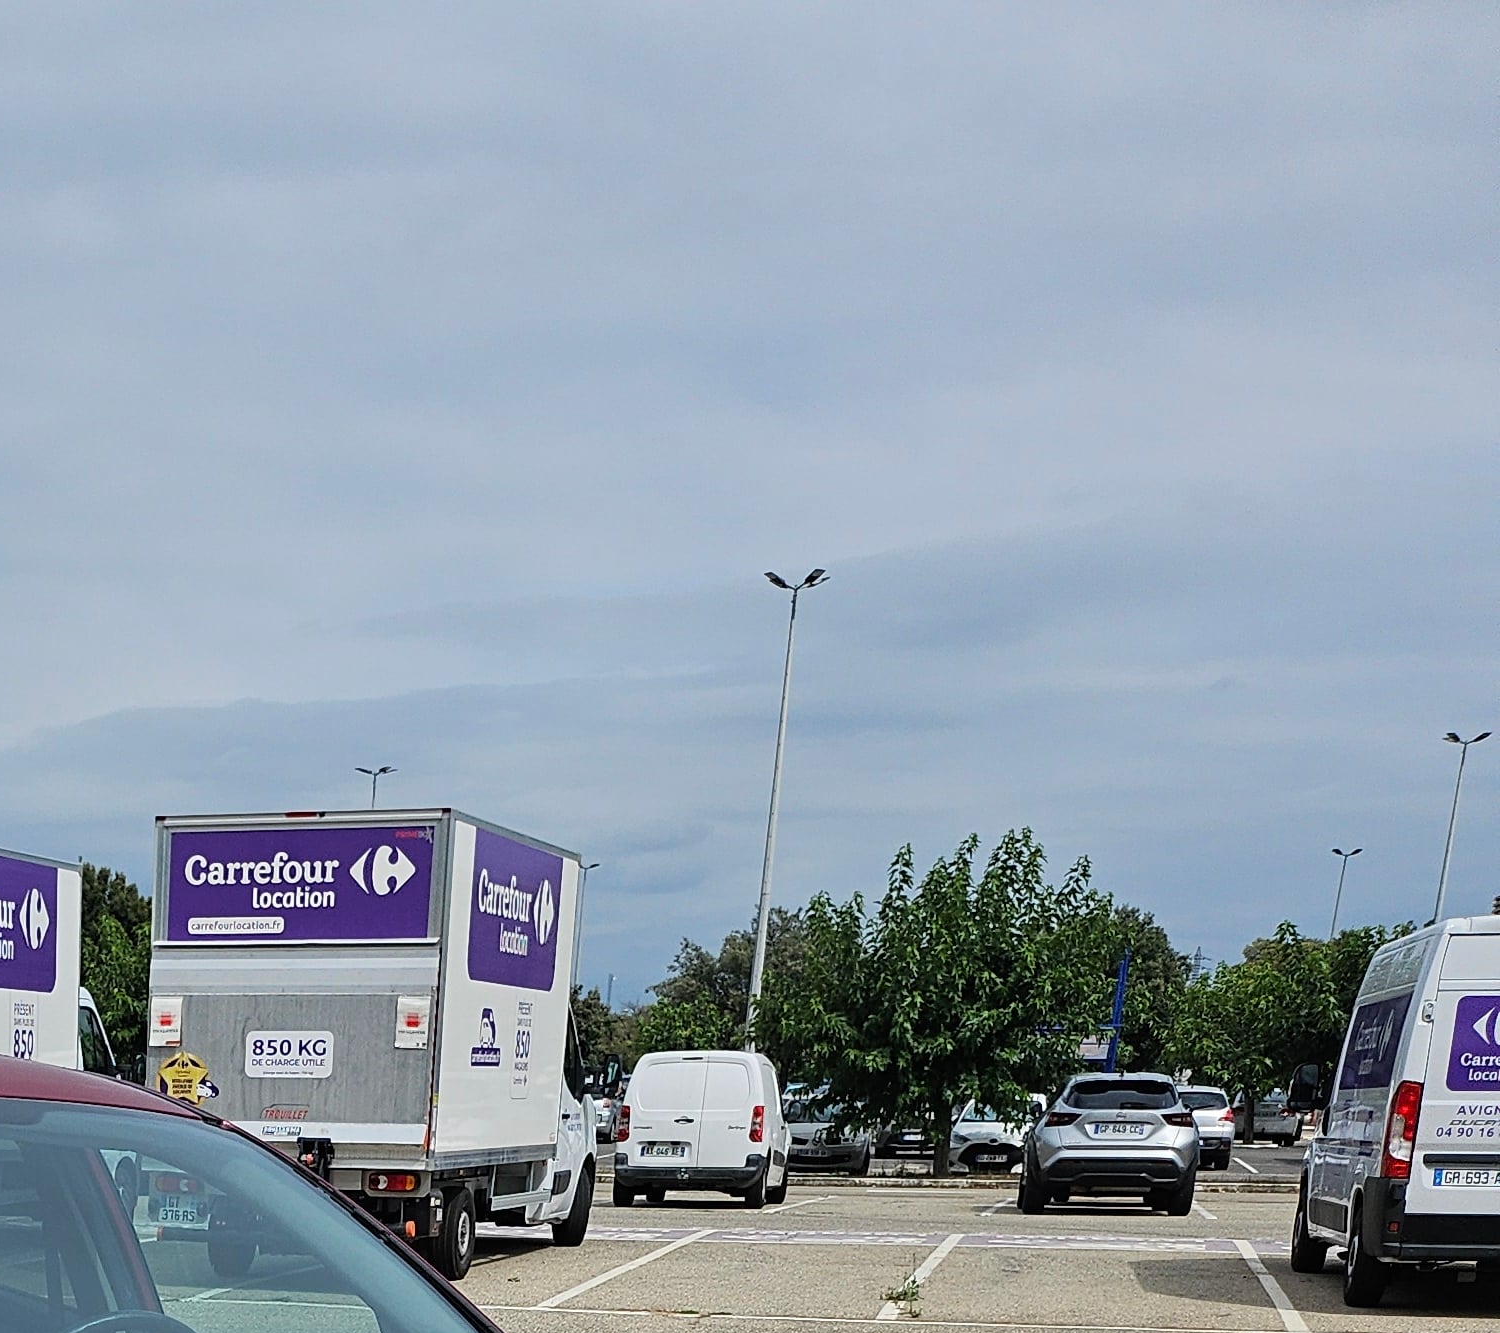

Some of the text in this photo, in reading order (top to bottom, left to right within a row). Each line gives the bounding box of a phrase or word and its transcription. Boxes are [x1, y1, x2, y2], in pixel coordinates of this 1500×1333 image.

[185, 852, 339, 885] Carrefour
[252, 886, 335, 908] location
[479, 868, 532, 922] Carrefour
[191, 920, 281, 931] carrefourlocation.fr
[500, 923, 528, 956] location
[14, 1029, 34, 1059] 850
[252, 1039, 327, 1056] 850 KG
[515, 1030, 530, 1058] 850
[252, 1058, 325, 1066] DE CHARGE UTILE
[1468, 1069, 1500, 1081] loca
[264, 1110, 309, 1120] TROUILLET
[1436, 1127, 1494, 1138] 04 90 16
